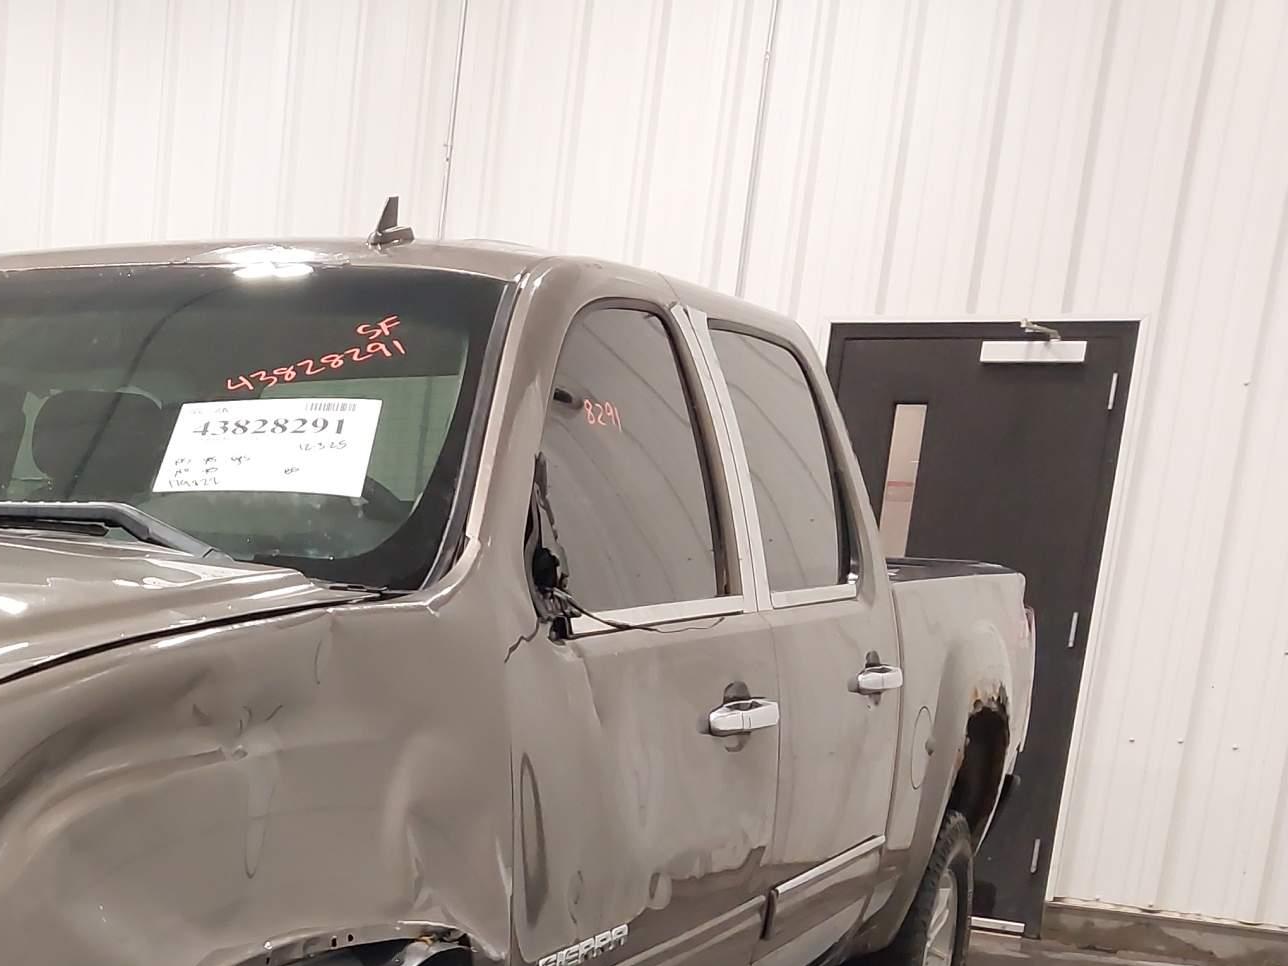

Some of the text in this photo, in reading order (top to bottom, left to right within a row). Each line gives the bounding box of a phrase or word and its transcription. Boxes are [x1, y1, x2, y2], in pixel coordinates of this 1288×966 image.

[356, 315, 400, 339] SF
[226, 340, 405, 391] 43828291
[192, 417, 346, 436] 43828291
[583, 399, 622, 432] 8291
